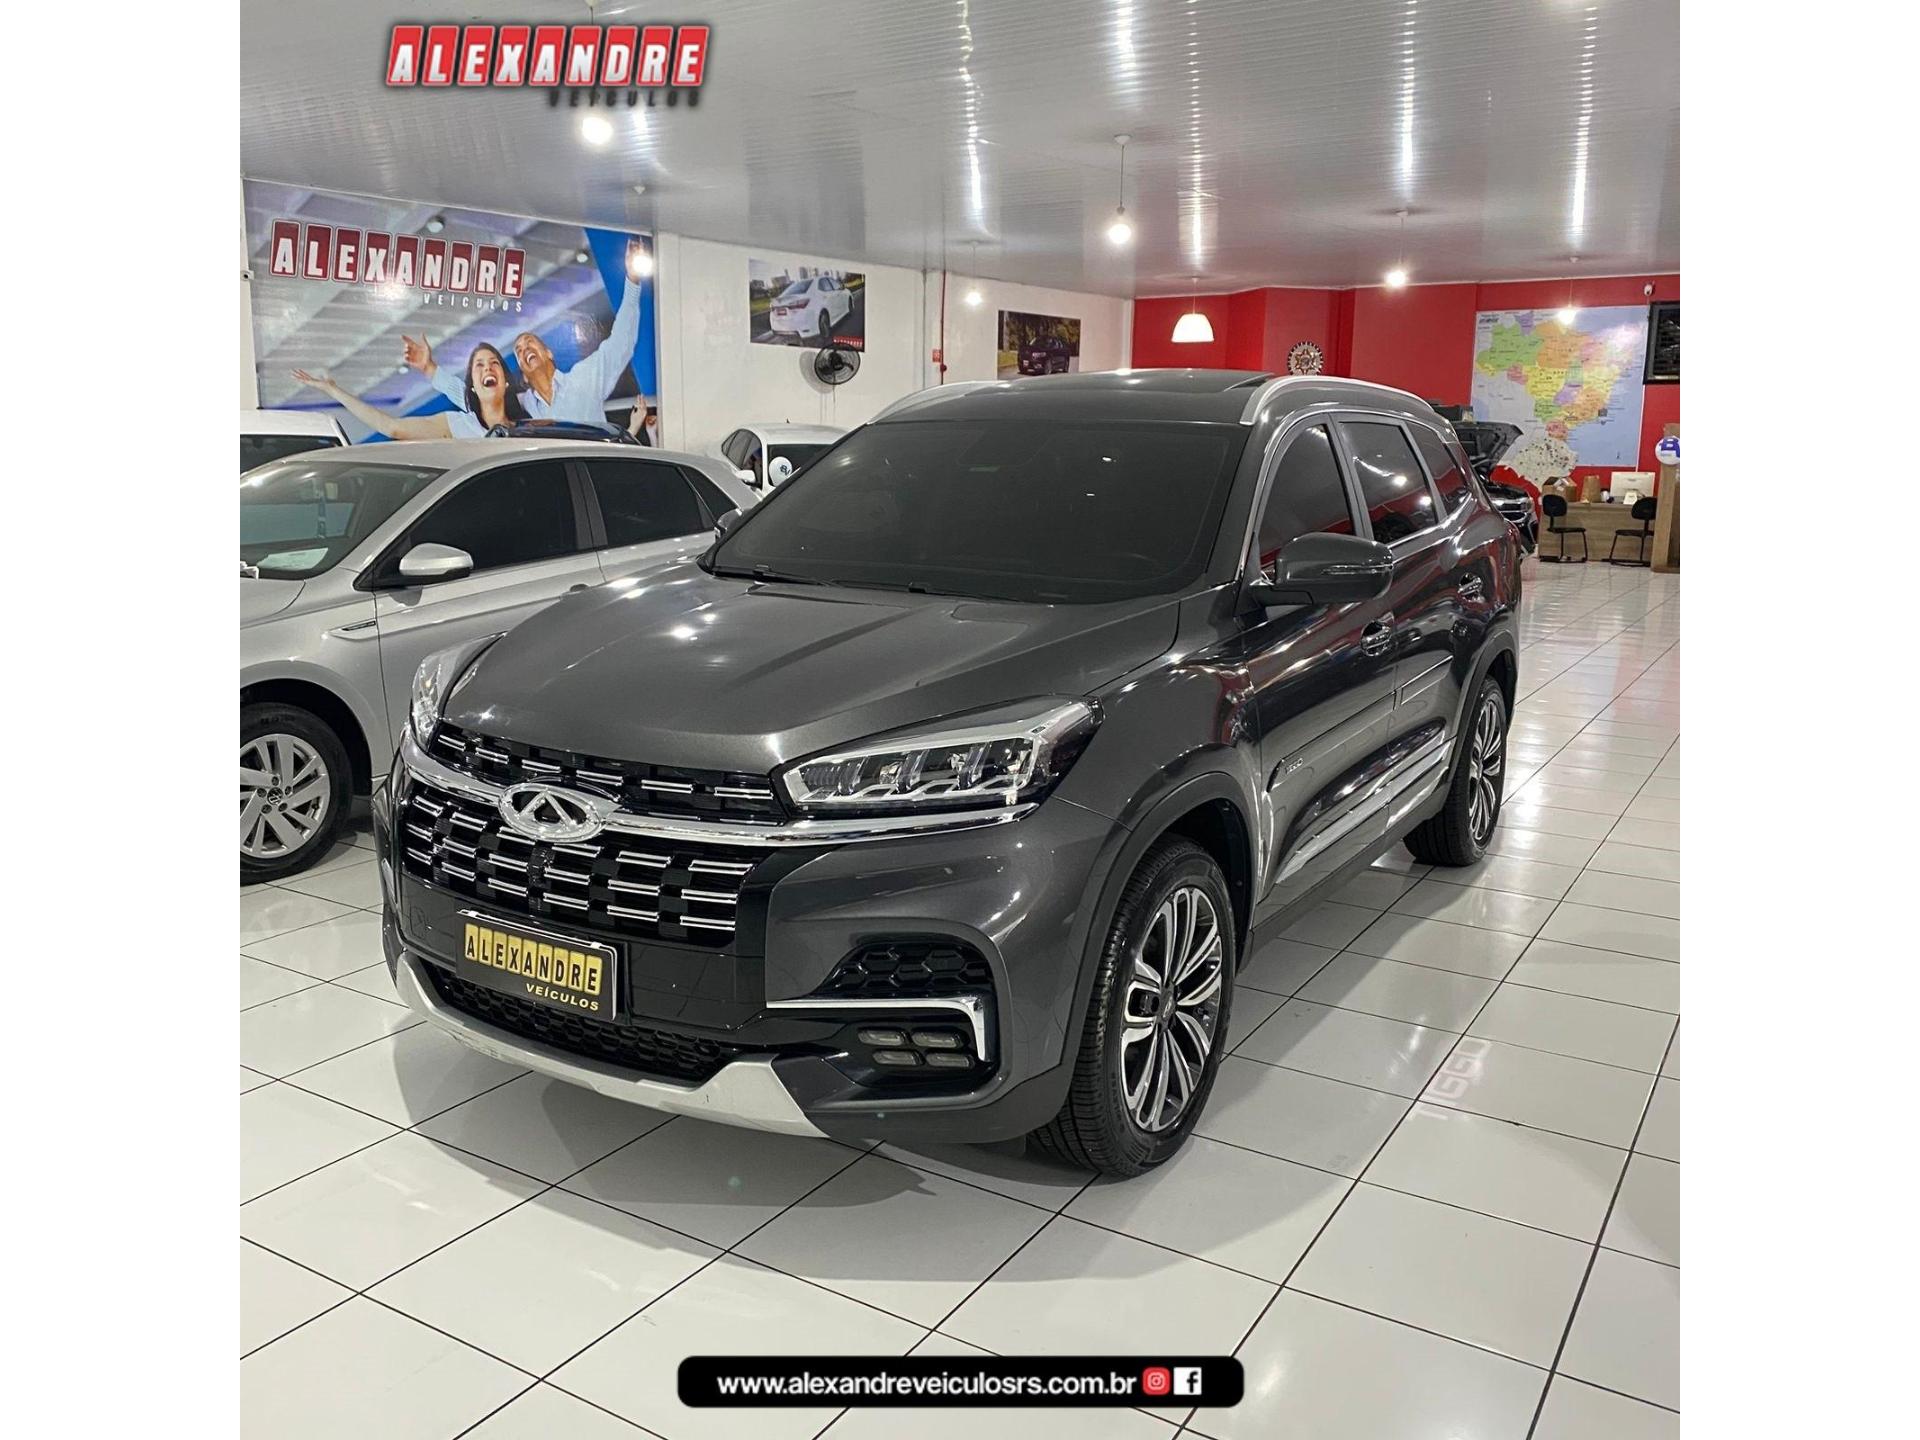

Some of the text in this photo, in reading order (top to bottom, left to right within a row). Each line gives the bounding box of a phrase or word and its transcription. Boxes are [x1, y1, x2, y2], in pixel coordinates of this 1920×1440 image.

[272, 237, 521, 295] ALEXANDRE
[466, 935, 598, 992] ALEXANDRE
[525, 983, 600, 1012] VEÍCULOS
